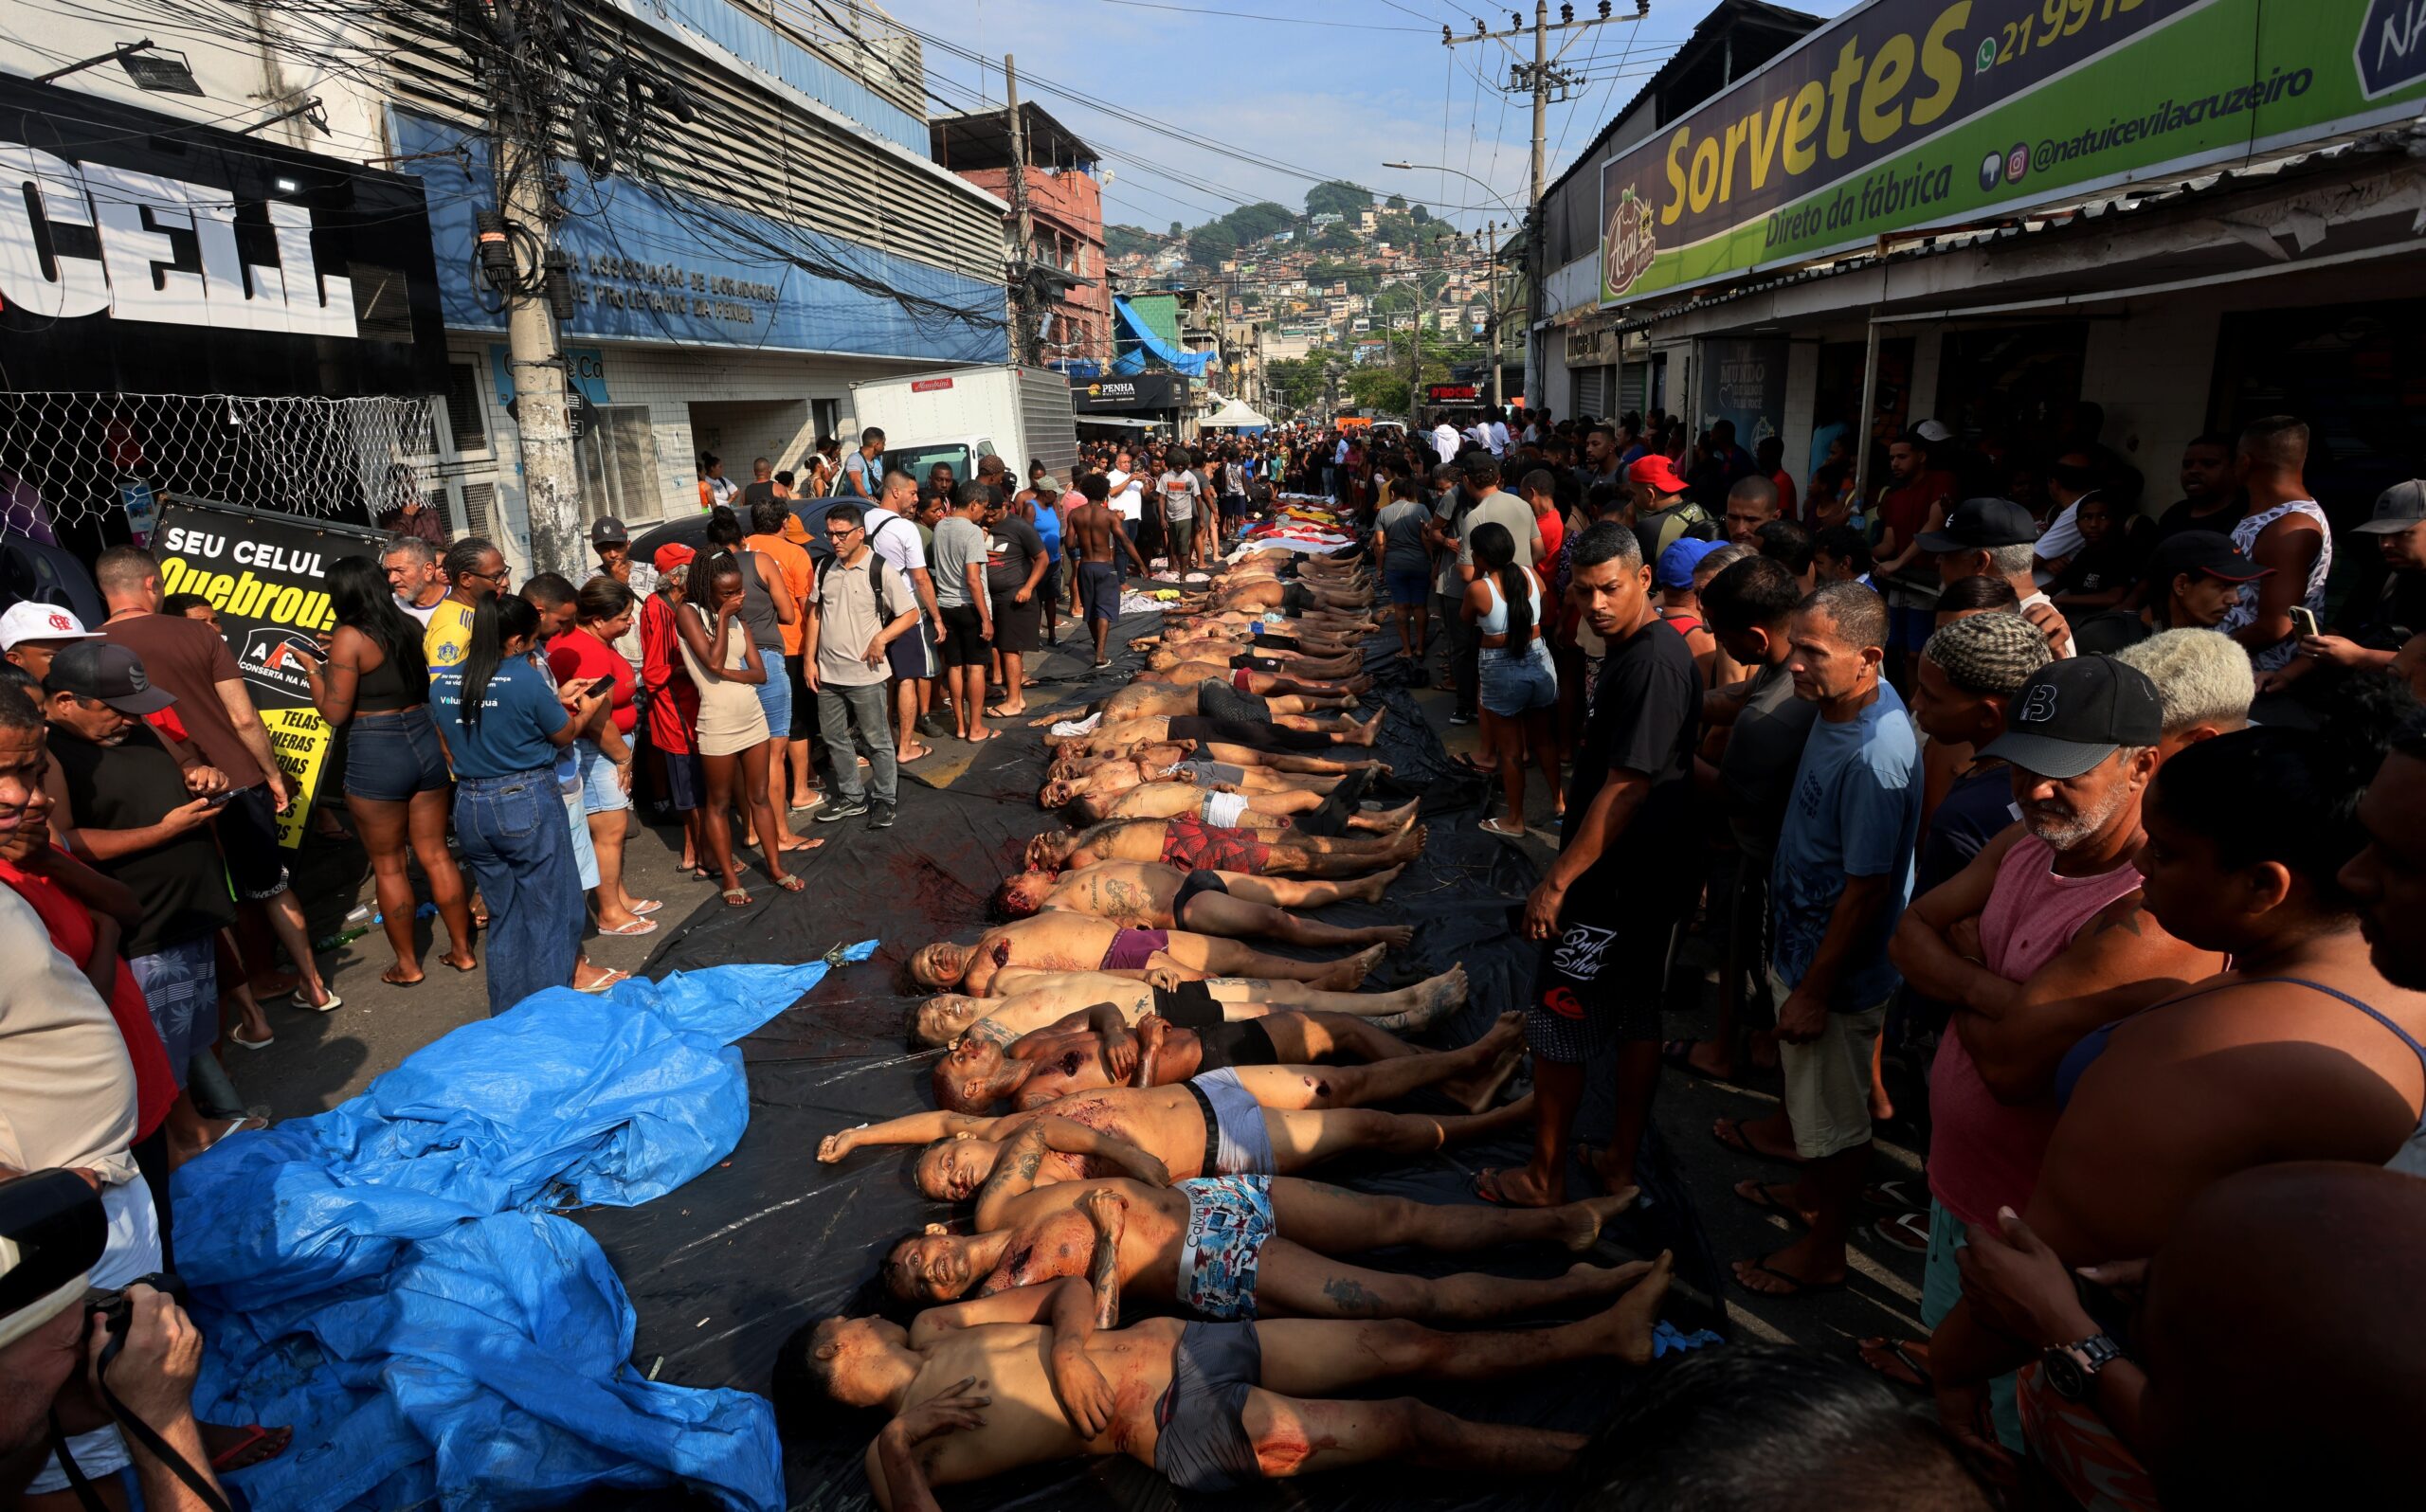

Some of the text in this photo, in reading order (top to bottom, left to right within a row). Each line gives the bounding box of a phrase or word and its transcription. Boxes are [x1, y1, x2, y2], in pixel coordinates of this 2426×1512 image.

[1996, 13, 2035, 65] 21
[1661, 0, 1972, 225] Sorvetes
[2032, 66, 2313, 173] @natuicevilacruzeiro
[1765, 160, 1954, 248] Direto da fábrica
[689, 271, 706, 293] DE
[1102, 383, 1135, 393] PENHA
[1720, 364, 1765, 383] MUNDO
[165, 527, 327, 578] SEU CELUL
[239, 661, 284, 681] CONSERTA
[285, 675, 299, 685] NA
[281, 711, 322, 731] TELAS
[1551, 947, 1610, 975] Silver
[1186, 1207, 1205, 1248] Calvin
